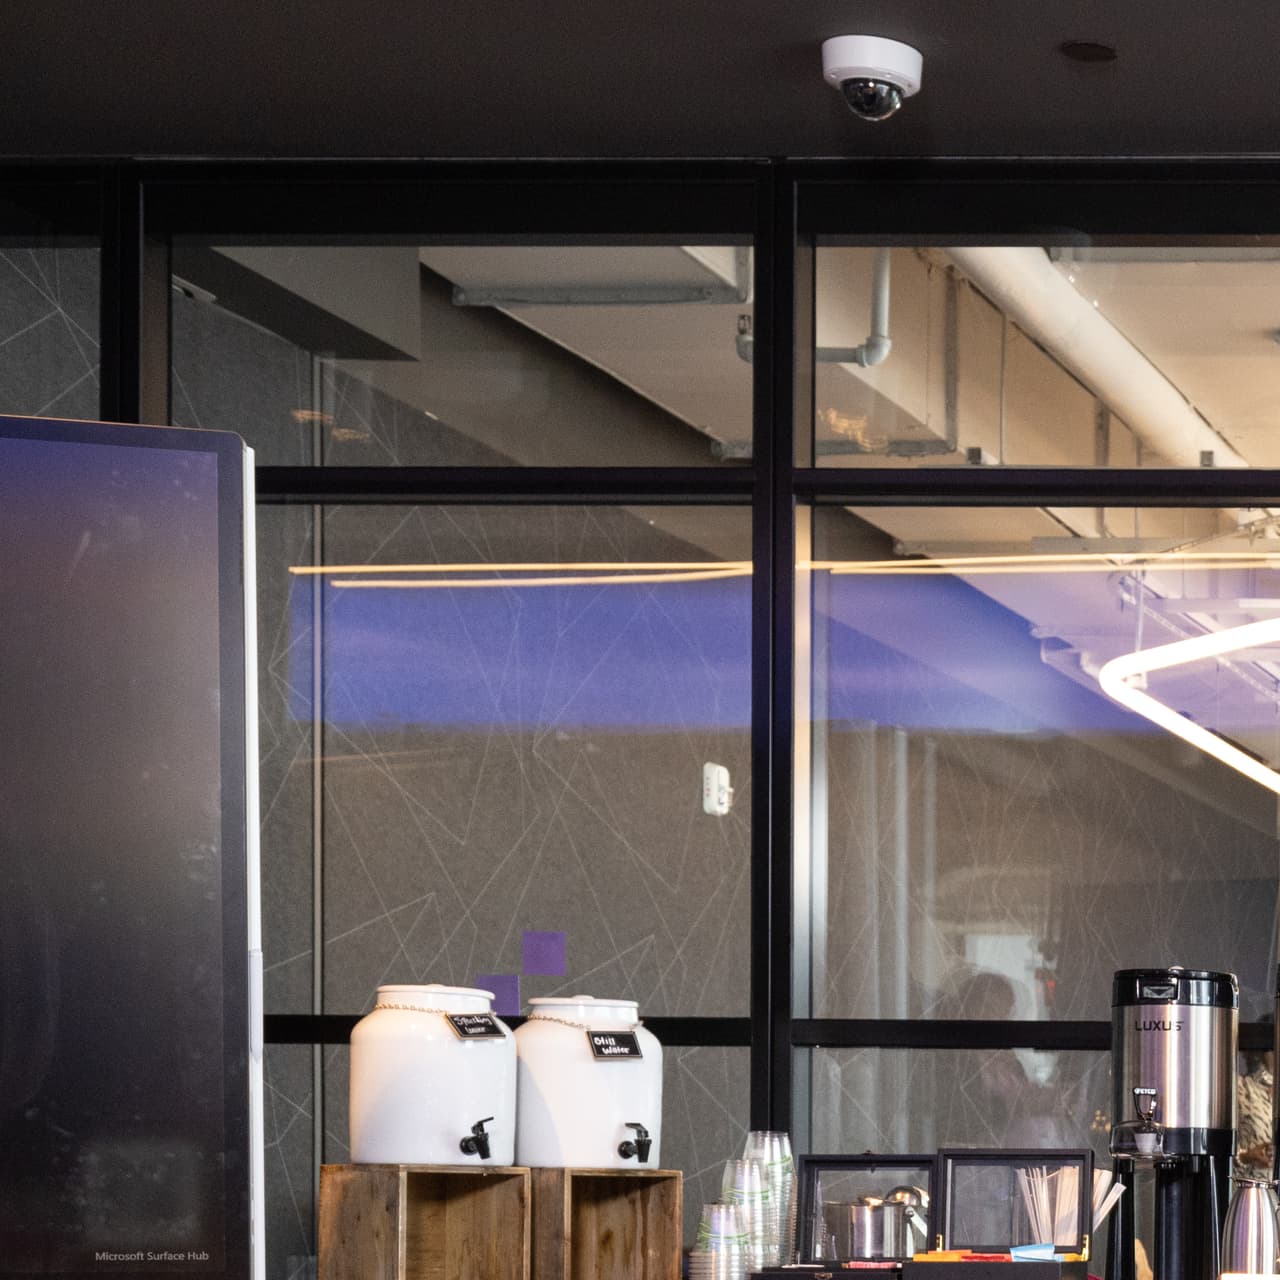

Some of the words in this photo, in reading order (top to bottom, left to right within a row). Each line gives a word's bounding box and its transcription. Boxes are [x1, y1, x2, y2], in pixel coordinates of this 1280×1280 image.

[1134, 1020, 1184, 1031] LUXUS
[95, 1251, 144, 1261] Microsoft
[146, 1251, 185, 1261] Surface
[187, 1251, 209, 1261] Hub
